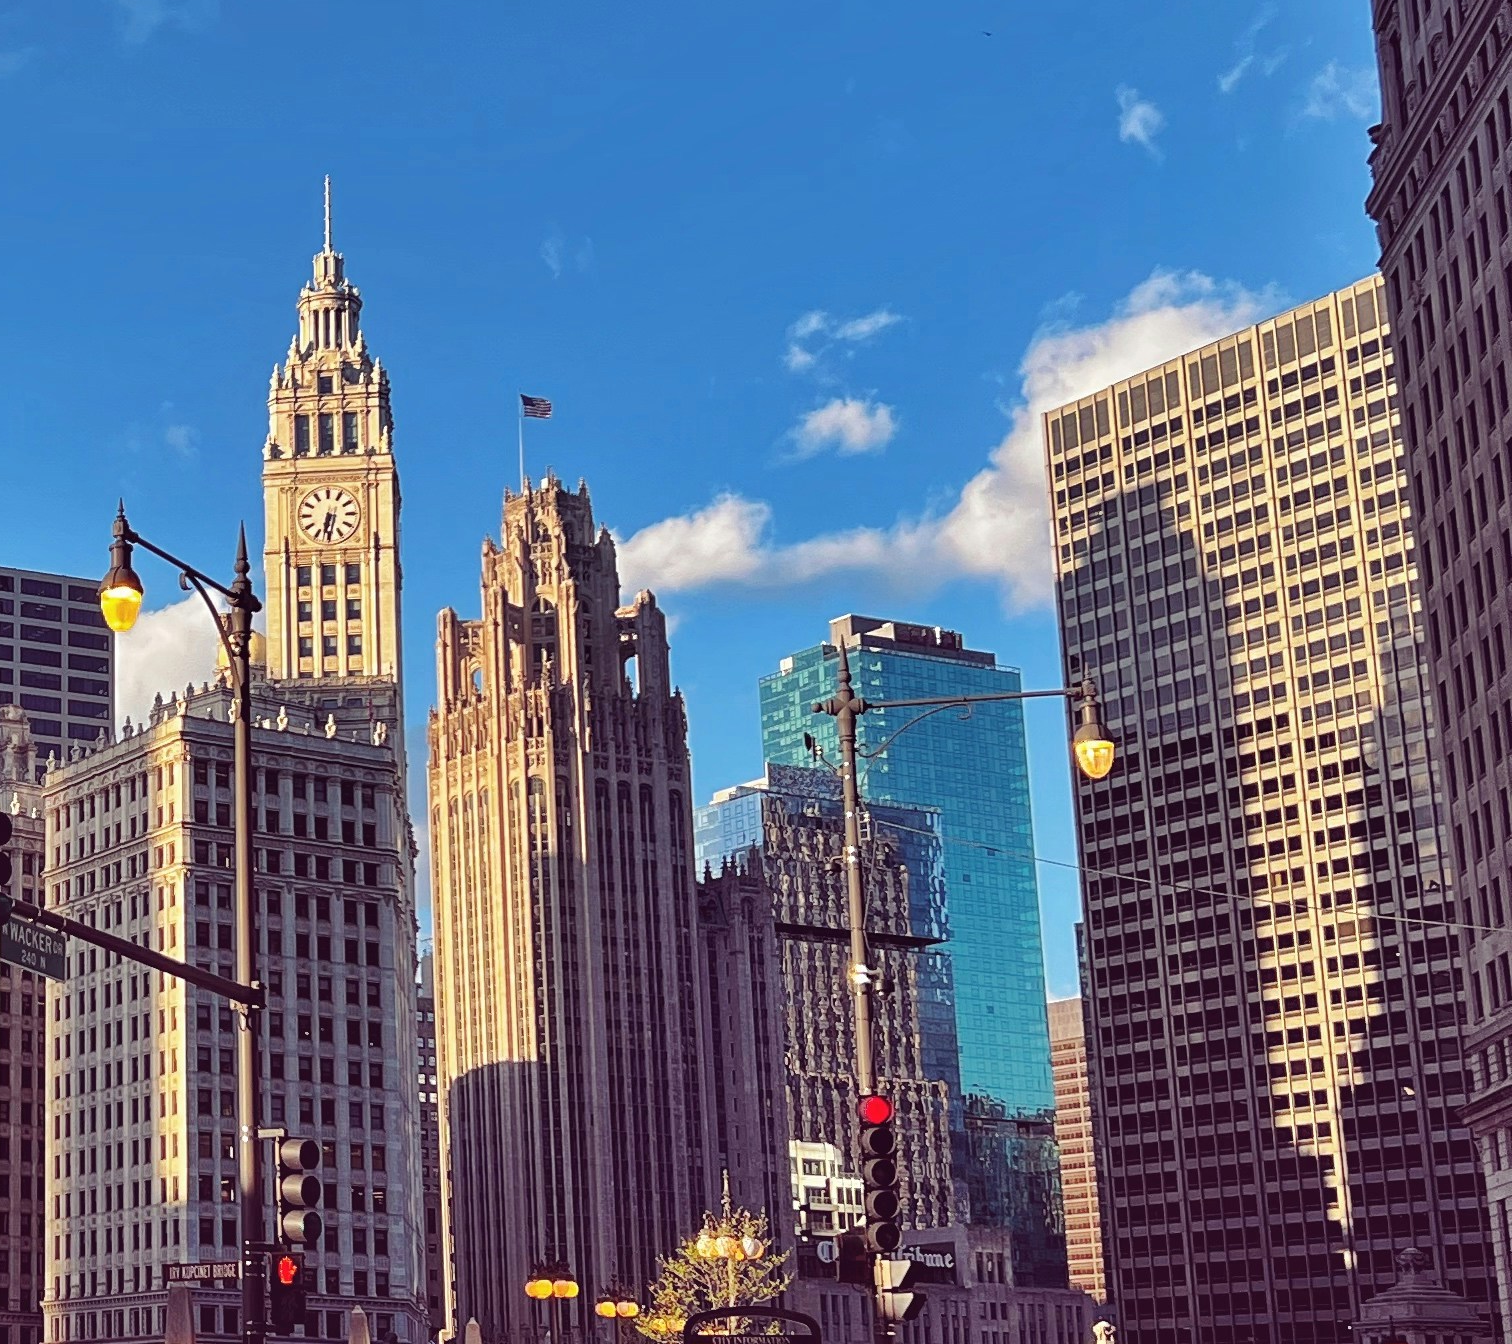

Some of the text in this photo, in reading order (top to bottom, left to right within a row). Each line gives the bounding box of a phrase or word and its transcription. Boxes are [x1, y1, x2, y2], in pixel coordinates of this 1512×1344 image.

[10, 922, 52, 955] WACKER
[52, 940, 64, 957] DR
[212, 1263, 237, 1278] BRIDGE
[712, 1336, 791, 1344] CITY INFORMATION
